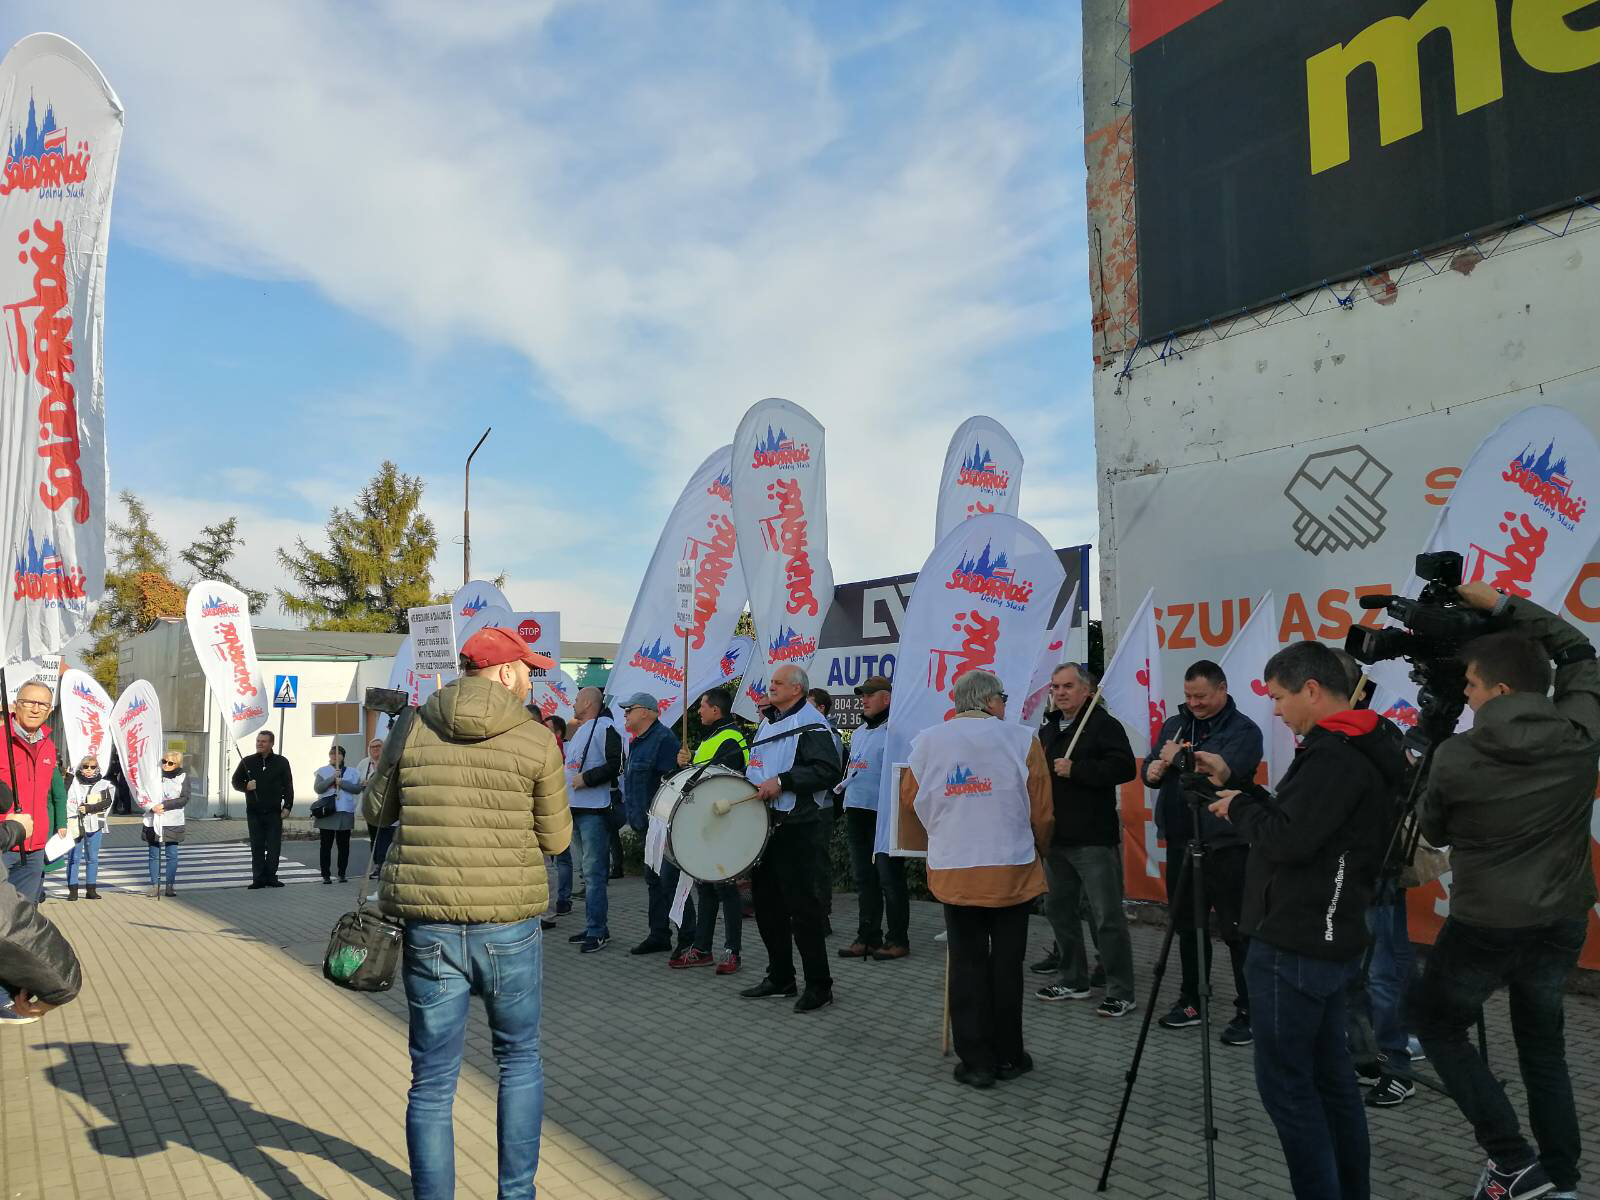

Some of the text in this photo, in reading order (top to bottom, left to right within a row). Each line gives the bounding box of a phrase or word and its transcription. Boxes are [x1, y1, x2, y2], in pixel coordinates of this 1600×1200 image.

[980, 593, 1003, 607] Dolny
[1154, 584, 1393, 650] ZUASZ
[519, 627, 540, 636] STOP
[834, 698, 852, 710] 804
